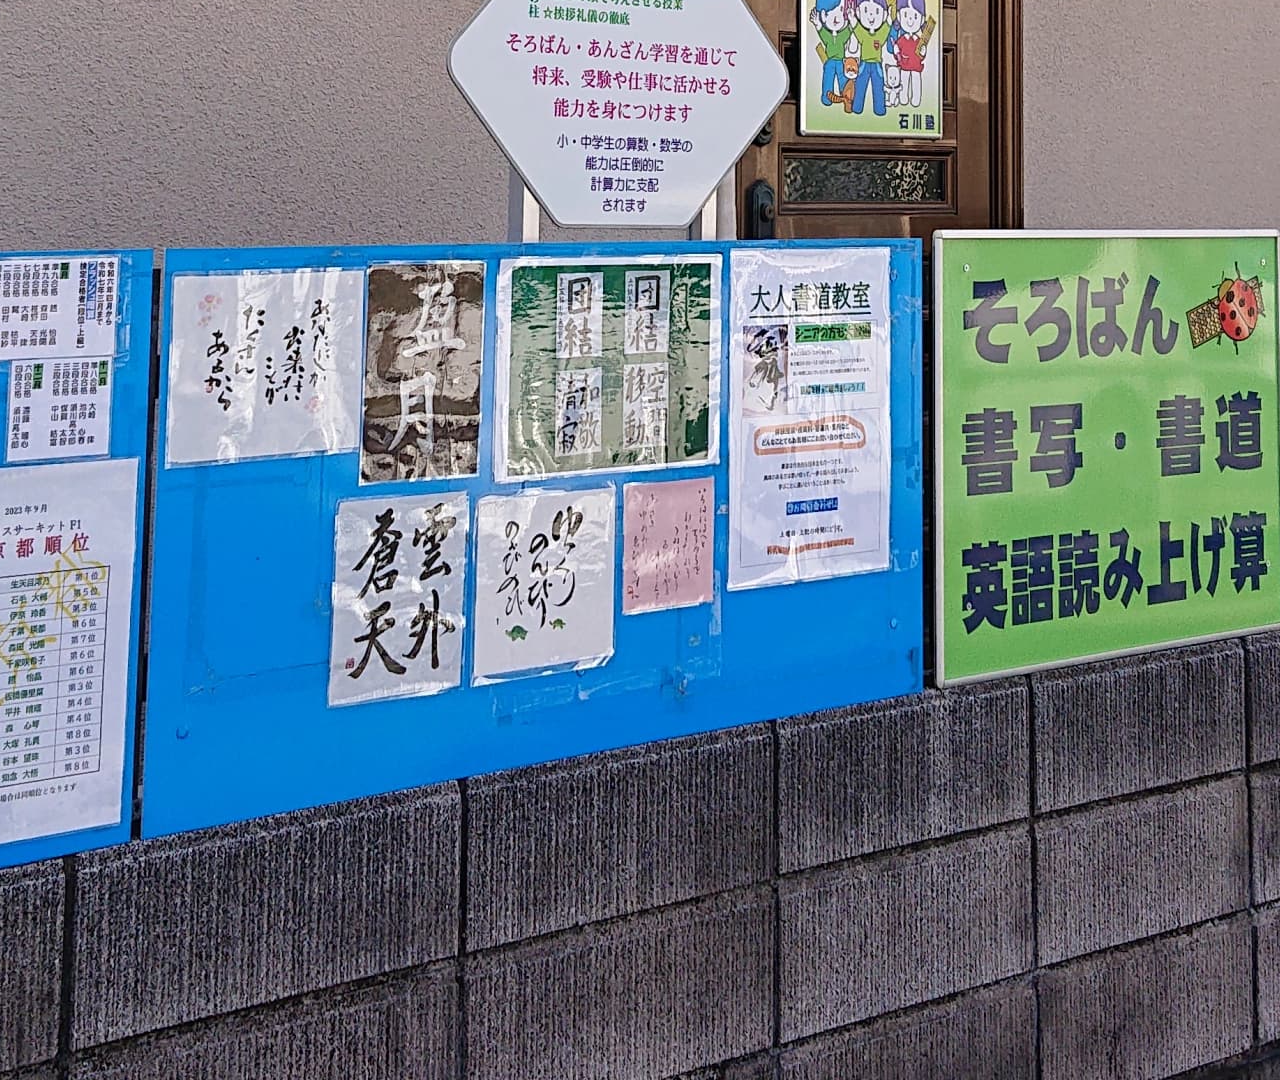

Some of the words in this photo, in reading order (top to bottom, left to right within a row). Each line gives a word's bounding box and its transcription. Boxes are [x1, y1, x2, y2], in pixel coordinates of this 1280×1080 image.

[506, 32, 738, 67] そろばん・あんざん学習を通じて
[553, 98, 693, 123] 能力を身につけます
[899, 113, 935, 130] 石川塾
[556, 133, 693, 153] 小・中学生の算数・数学の
[585, 156, 664, 172] 能力は圧倒的に
[590, 176, 660, 192] 計算力に支配
[602, 198, 647, 212] されます
[750, 281, 871, 312] 大人書道教室
[963, 272, 1180, 364] そろばん
[960, 391, 1265, 497] 書写・書道
[5, 503, 48, 515] 2023年9月
[960, 511, 1269, 635] 英語読み上げ算
